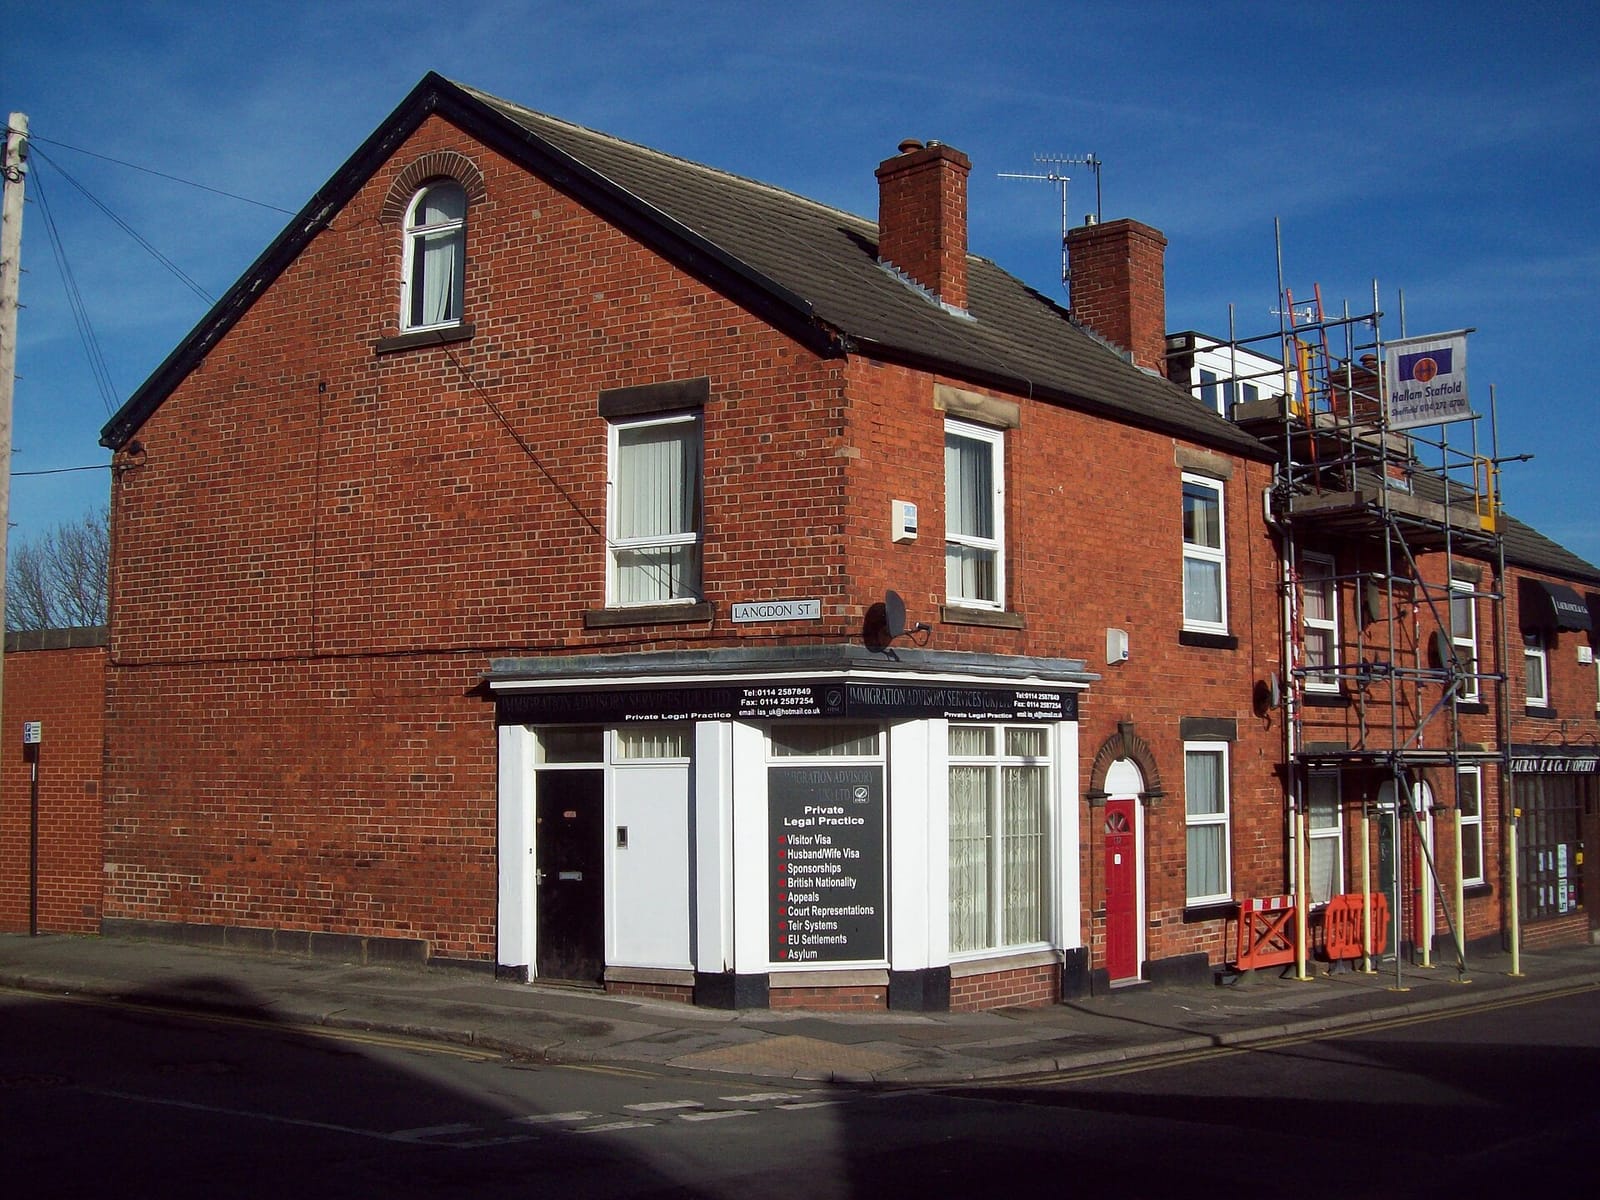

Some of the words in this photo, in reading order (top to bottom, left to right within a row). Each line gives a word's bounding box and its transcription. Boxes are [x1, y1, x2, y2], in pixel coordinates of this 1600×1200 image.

[1392, 389, 1422, 403] Hallam
[1425, 381, 1462, 398] Scaffold
[735, 605, 792, 618] LANGDON
[797, 604, 811, 615] ST
[780, 697, 814, 705] 2587254
[849, 687, 906, 705] IMMIGRATION
[906, 688, 946, 706] ADVISORY
[1510, 759, 1547, 772] LAURANE
[834, 770, 873, 783] ADVISORY
[804, 806, 844, 815] Private
[784, 817, 815, 827] Legal
[818, 816, 865, 826] Practice
[787, 834, 813, 845] Visitor
[814, 834, 832, 844] Visa
[787, 849, 842, 860] Husband/Wife
[843, 848, 860, 858] Visa
[787, 862, 842, 875] Sponsorships
[787, 877, 814, 888] British
[815, 877, 857, 889] Nationality
[787, 892, 820, 904] Appeals
[787, 906, 810, 917] Court
[811, 905, 875, 918] Representations
[787, 920, 802, 930] Teir
[804, 920, 838, 934] Systems
[788, 934, 800, 945] EU
[801, 934, 848, 945] Settlements
[787, 948, 818, 961] Asylum
